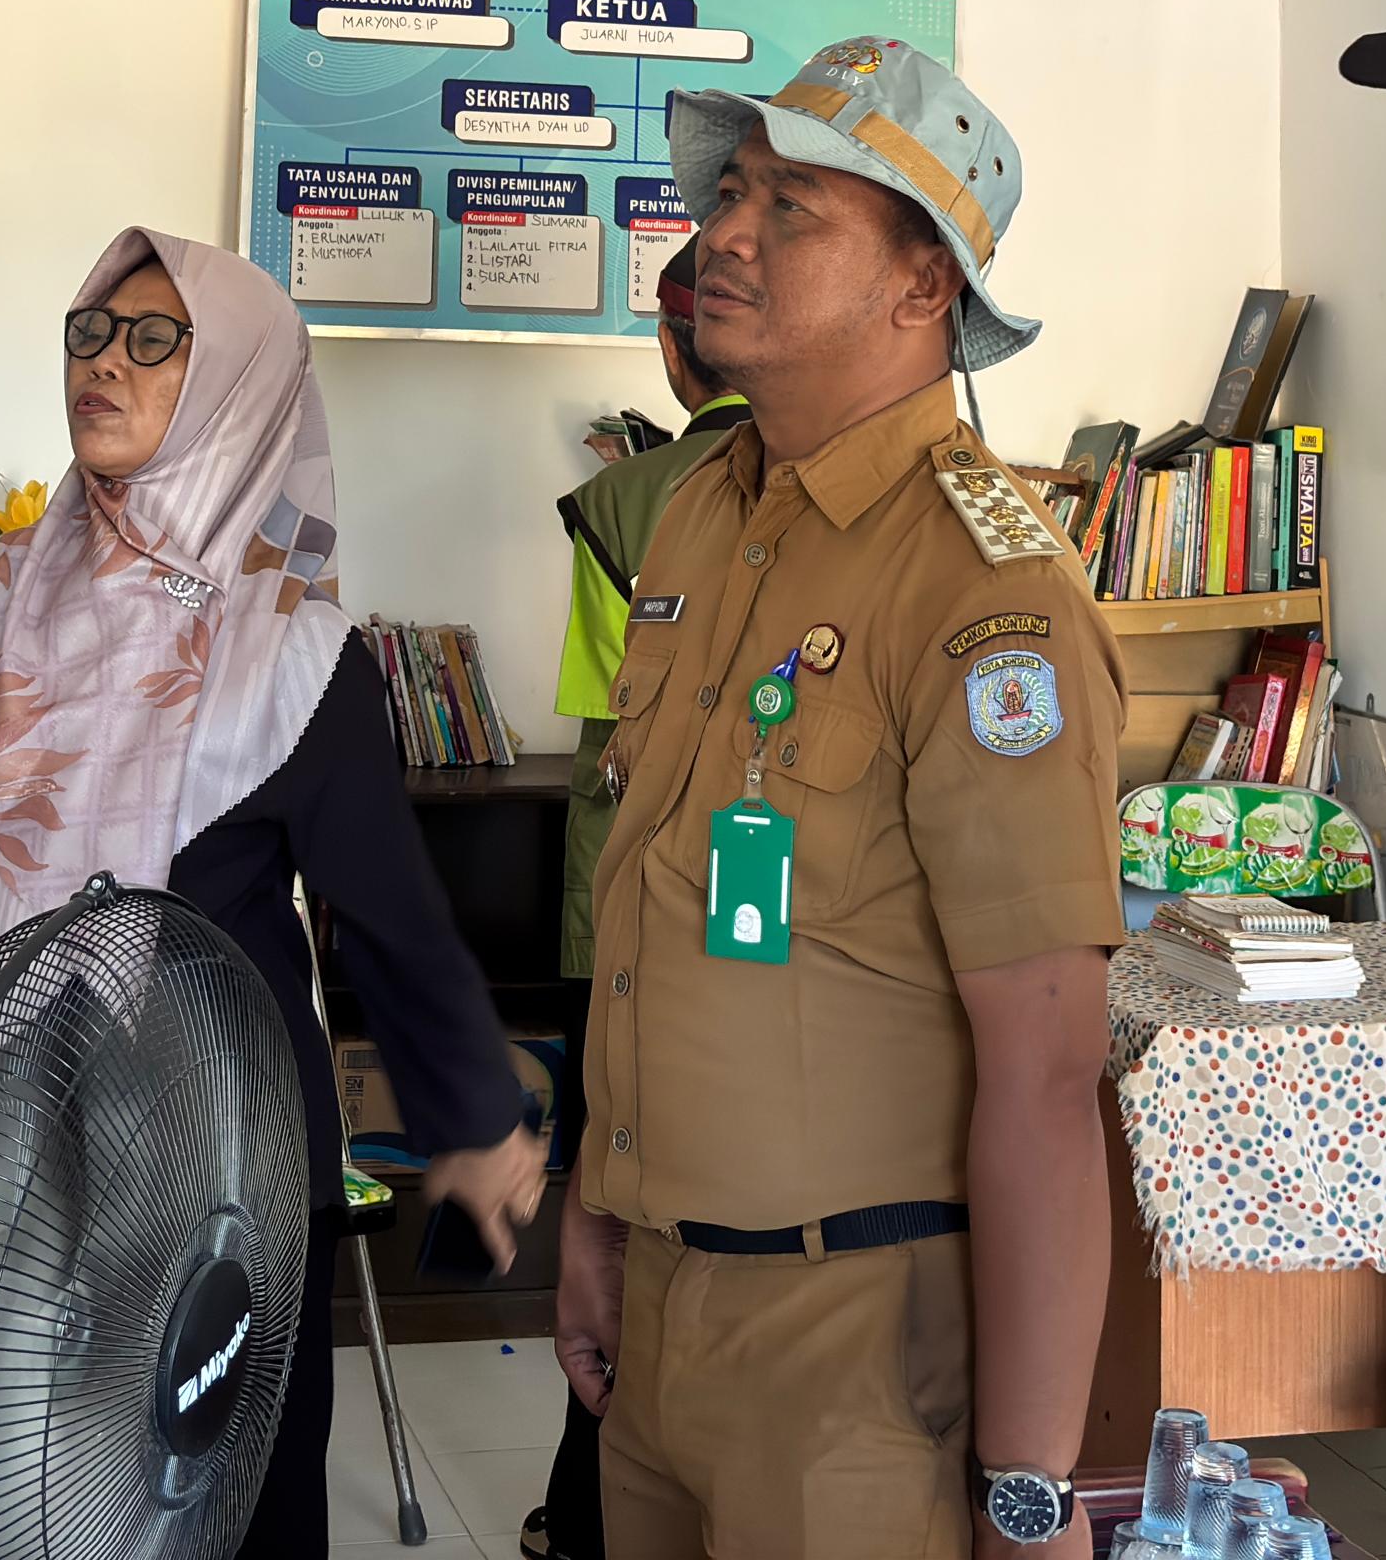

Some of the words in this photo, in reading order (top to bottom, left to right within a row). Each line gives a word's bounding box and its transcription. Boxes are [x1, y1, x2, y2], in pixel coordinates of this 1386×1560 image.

[581, 29, 627, 42] JUARNI
[639, 29, 674, 43] HUDA
[465, 89, 570, 111] SEKRETARIS
[464, 118, 530, 133] DESYNTHA
[538, 120, 568, 133] DYAH
[287, 169, 321, 182] TATA
[326, 171, 377, 184] USAHA
[382, 173, 412, 185] DAN
[457, 176, 496, 189] DIVISI
[500, 178, 576, 193] PEMILIHAN/
[299, 186, 399, 201] PENYULUHAN
[467, 193, 565, 208] PENGUMPULAN
[630, 200, 690, 214] PENYIM
[413, 212, 424, 221] M
[531, 215, 587, 228] SUMARNI
[298, 234, 308, 243] 1.
[467, 241, 478, 249] 1.
[479, 240, 541, 252] LAILATUL
[549, 242, 587, 251] FITRIA
[297, 248, 308, 258] 2.
[311, 247, 372, 260] MUSTHOFA
[467, 255, 477, 263] 2.
[481, 255, 531, 267] LISTARI
[467, 268, 477, 277] 3.
[478, 271, 540, 284] SURATNI
[952, 624, 993, 654] PEMKOT
[995, 618, 1045, 632] BONTANG
[200, 1311, 250, 1395] Miyako
